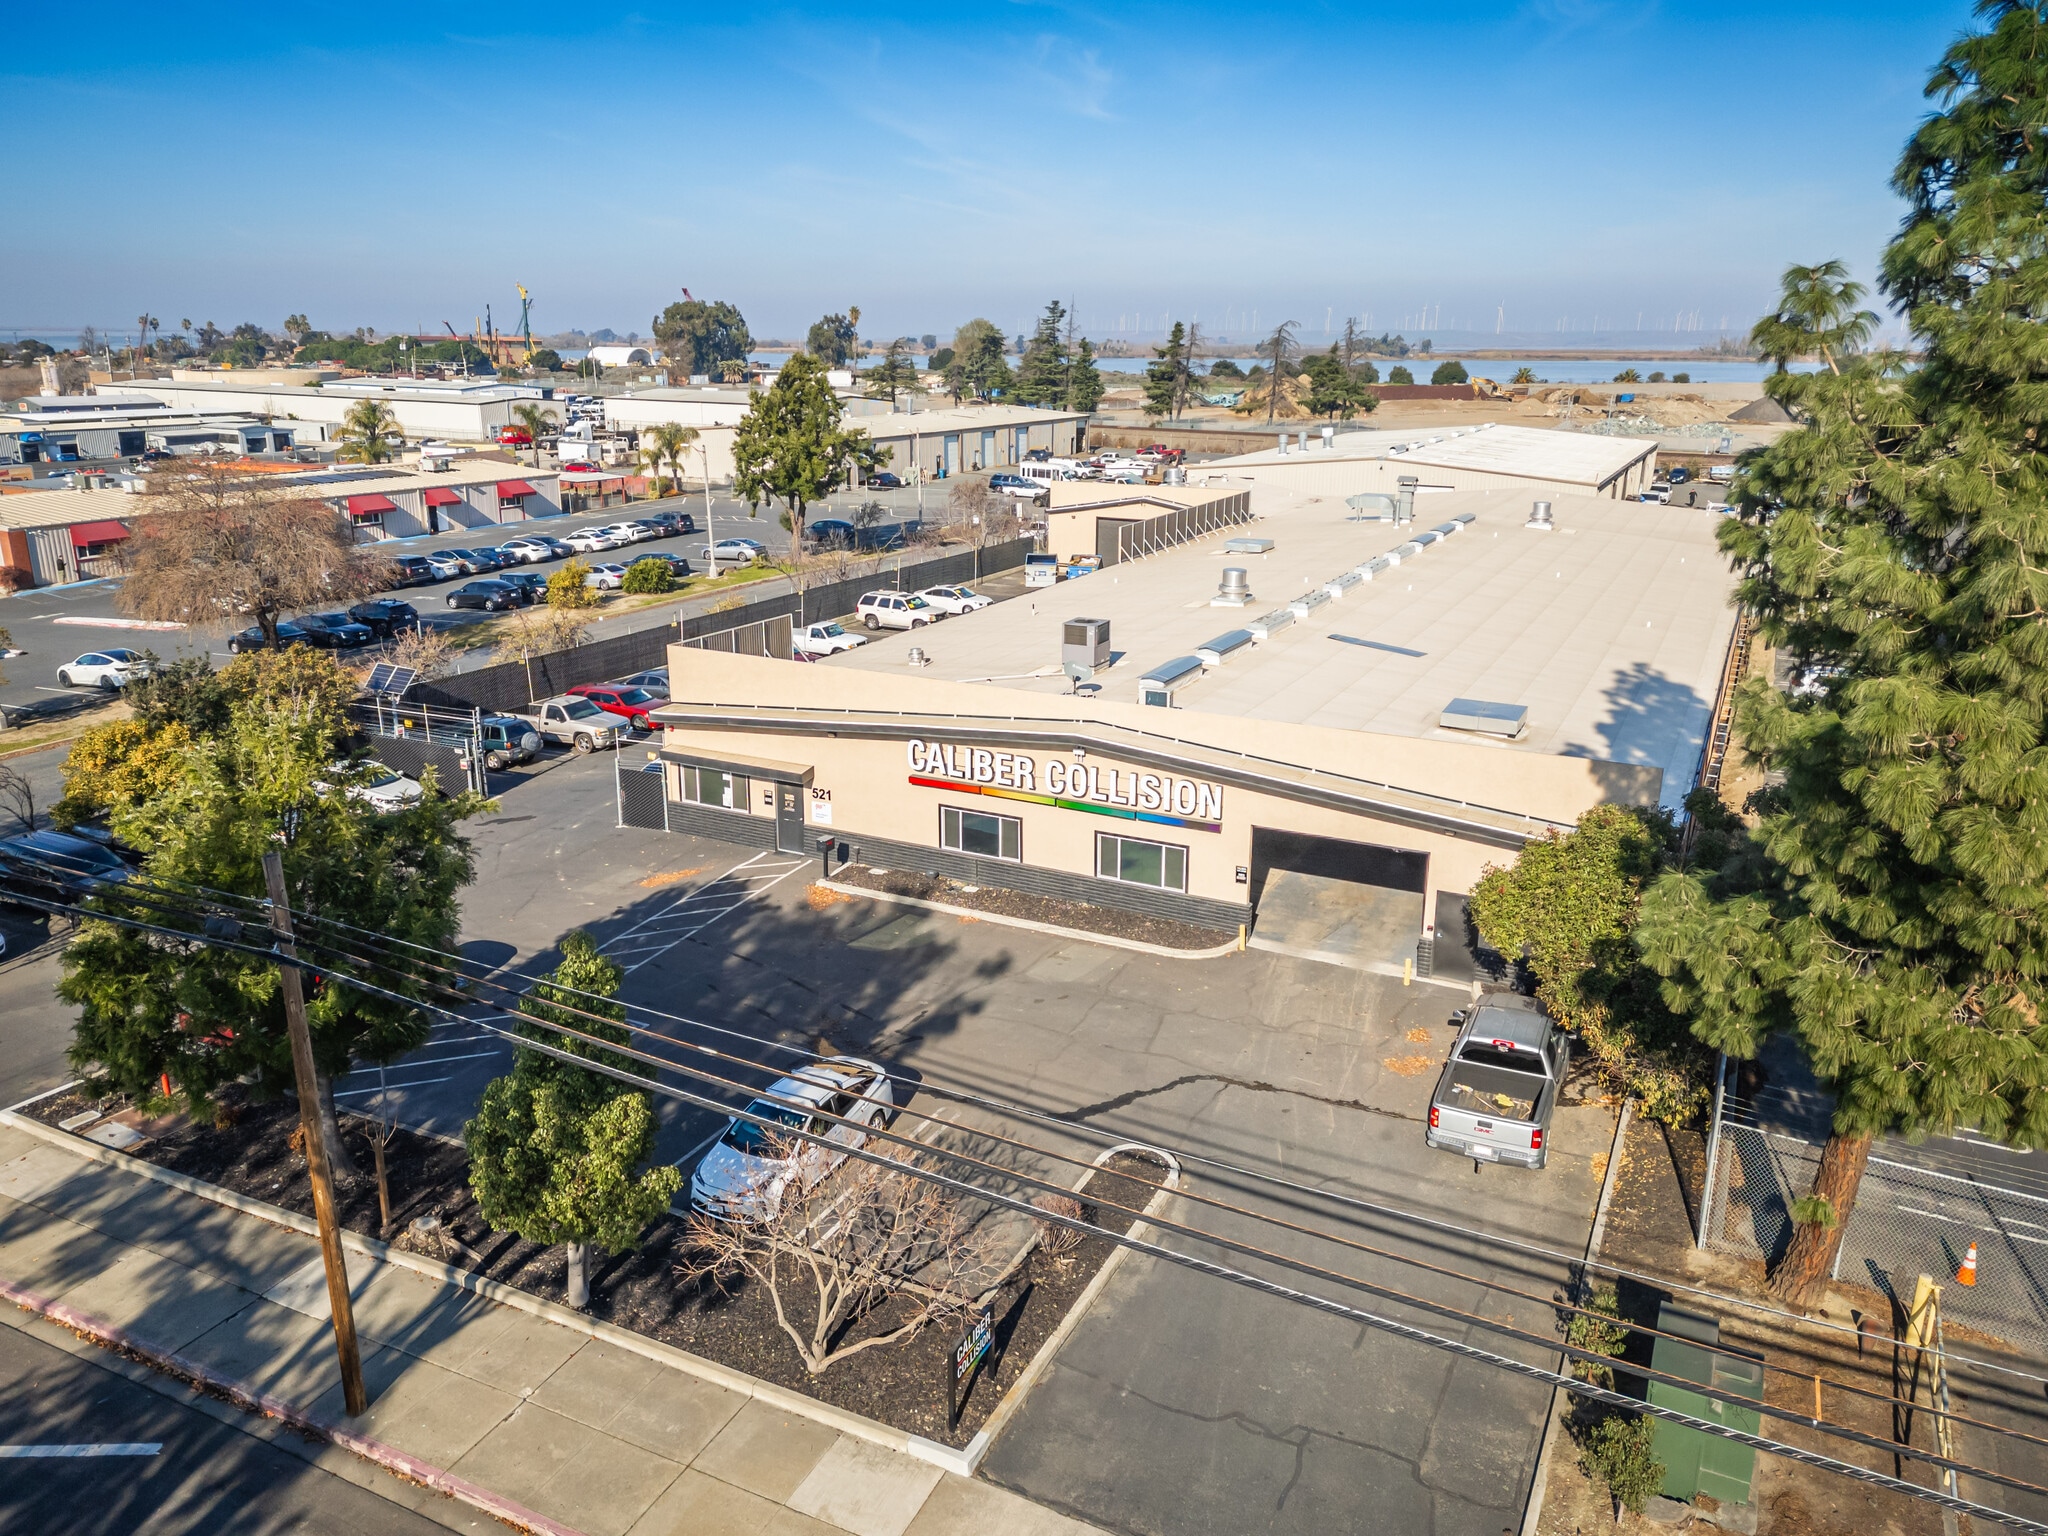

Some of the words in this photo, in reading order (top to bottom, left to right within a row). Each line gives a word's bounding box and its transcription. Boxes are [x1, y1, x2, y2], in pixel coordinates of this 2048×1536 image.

[812, 787, 832, 801] 521
[907, 738, 1036, 790] CALIBER
[1045, 759, 1224, 820] COLLISION
[1473, 1126, 1495, 1136] GMC
[956, 1311, 992, 1363] CALIBER
[956, 1328, 992, 1379] COLLISION
